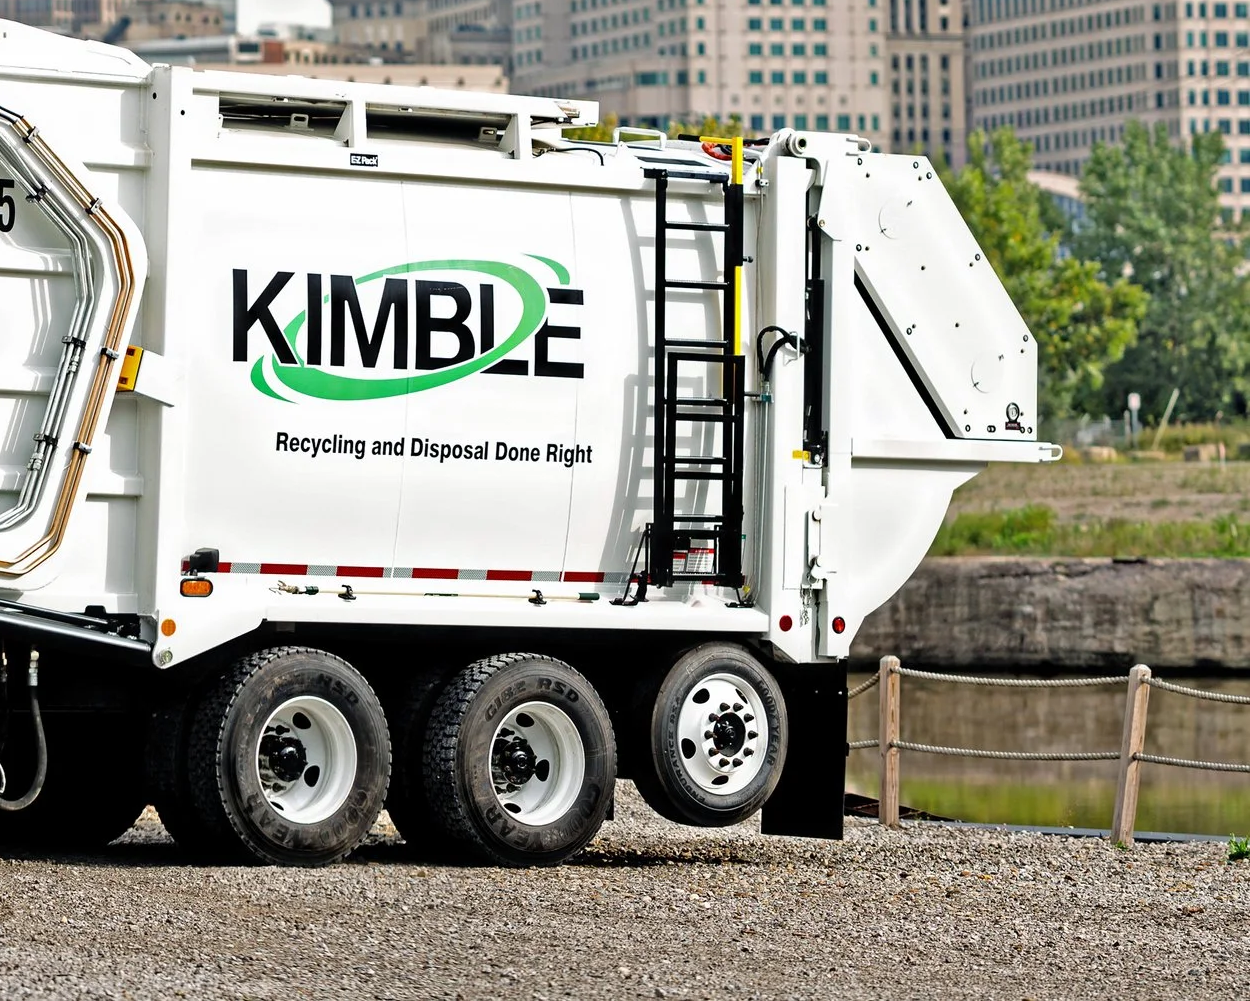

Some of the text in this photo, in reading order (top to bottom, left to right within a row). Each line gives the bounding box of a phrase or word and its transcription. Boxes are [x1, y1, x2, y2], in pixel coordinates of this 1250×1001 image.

[361, 156, 377, 165] Pack
[233, 268, 584, 378] KIMBLE
[276, 432, 593, 468] Recycling and Disposal Done Right
[536, 678, 579, 703] RSD
[757, 680, 781, 766] GOODYEAR
